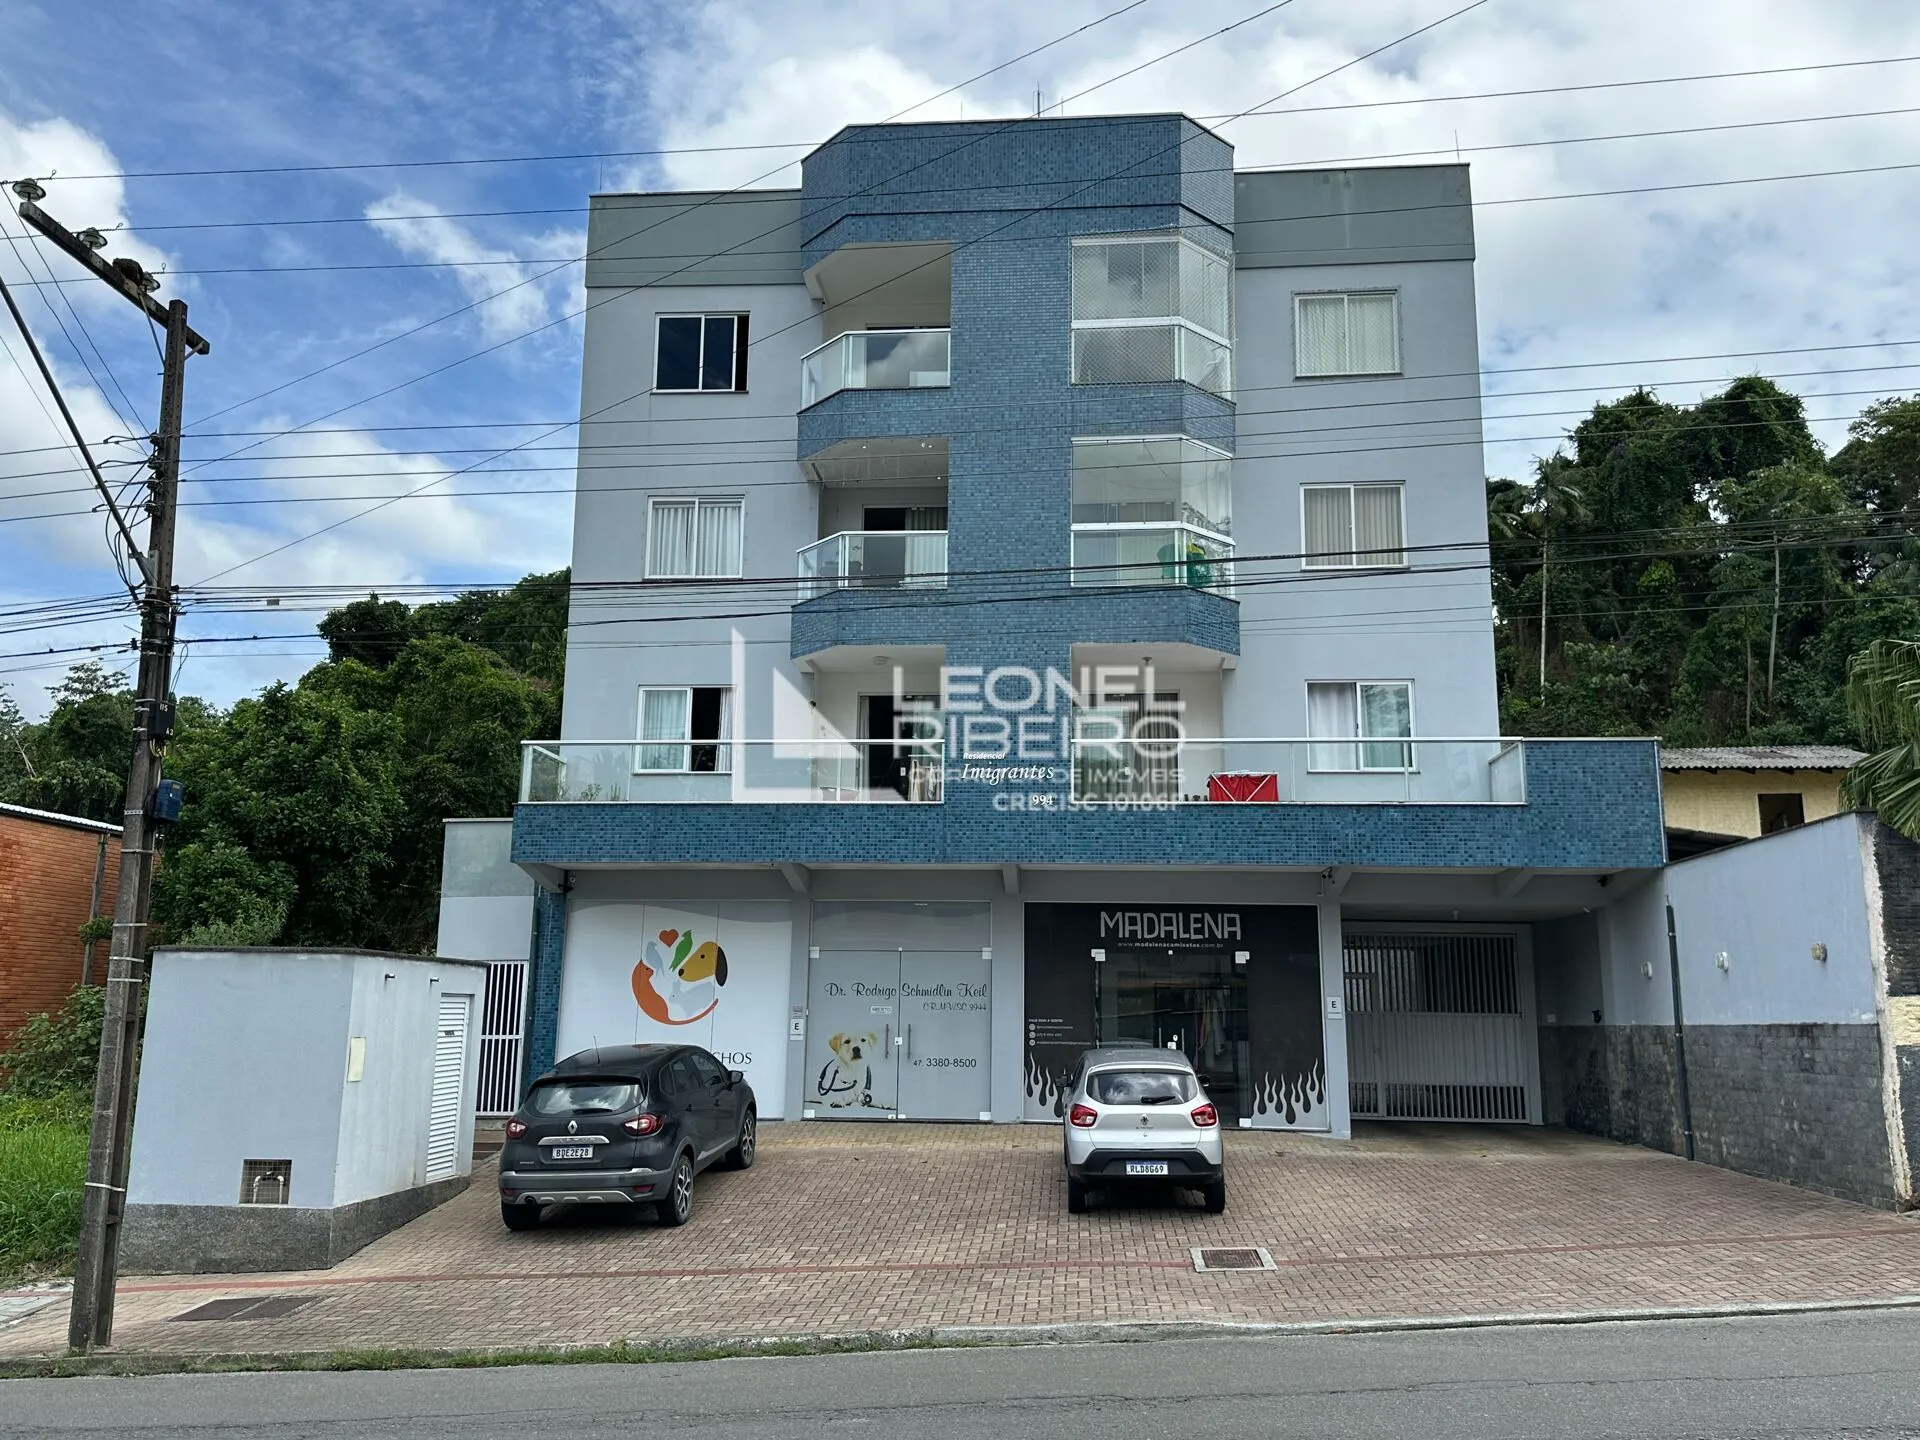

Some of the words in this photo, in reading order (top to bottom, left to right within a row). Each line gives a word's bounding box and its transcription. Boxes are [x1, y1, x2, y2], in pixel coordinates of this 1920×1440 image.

[959, 761, 1054, 786] Imigrantes
[1032, 794, 1054, 806] 994
[1100, 911, 1241, 940] MADALENA
[824, 982, 847, 997] Dr.
[850, 982, 897, 1000] Rodrigo
[901, 982, 952, 998] Schmidlin
[956, 982, 988, 998] Keil
[794, 1022, 800, 1031] E
[926, 1057, 977, 1068] 3380-8500
[1130, 1165, 1164, 1174] RLD8G69
